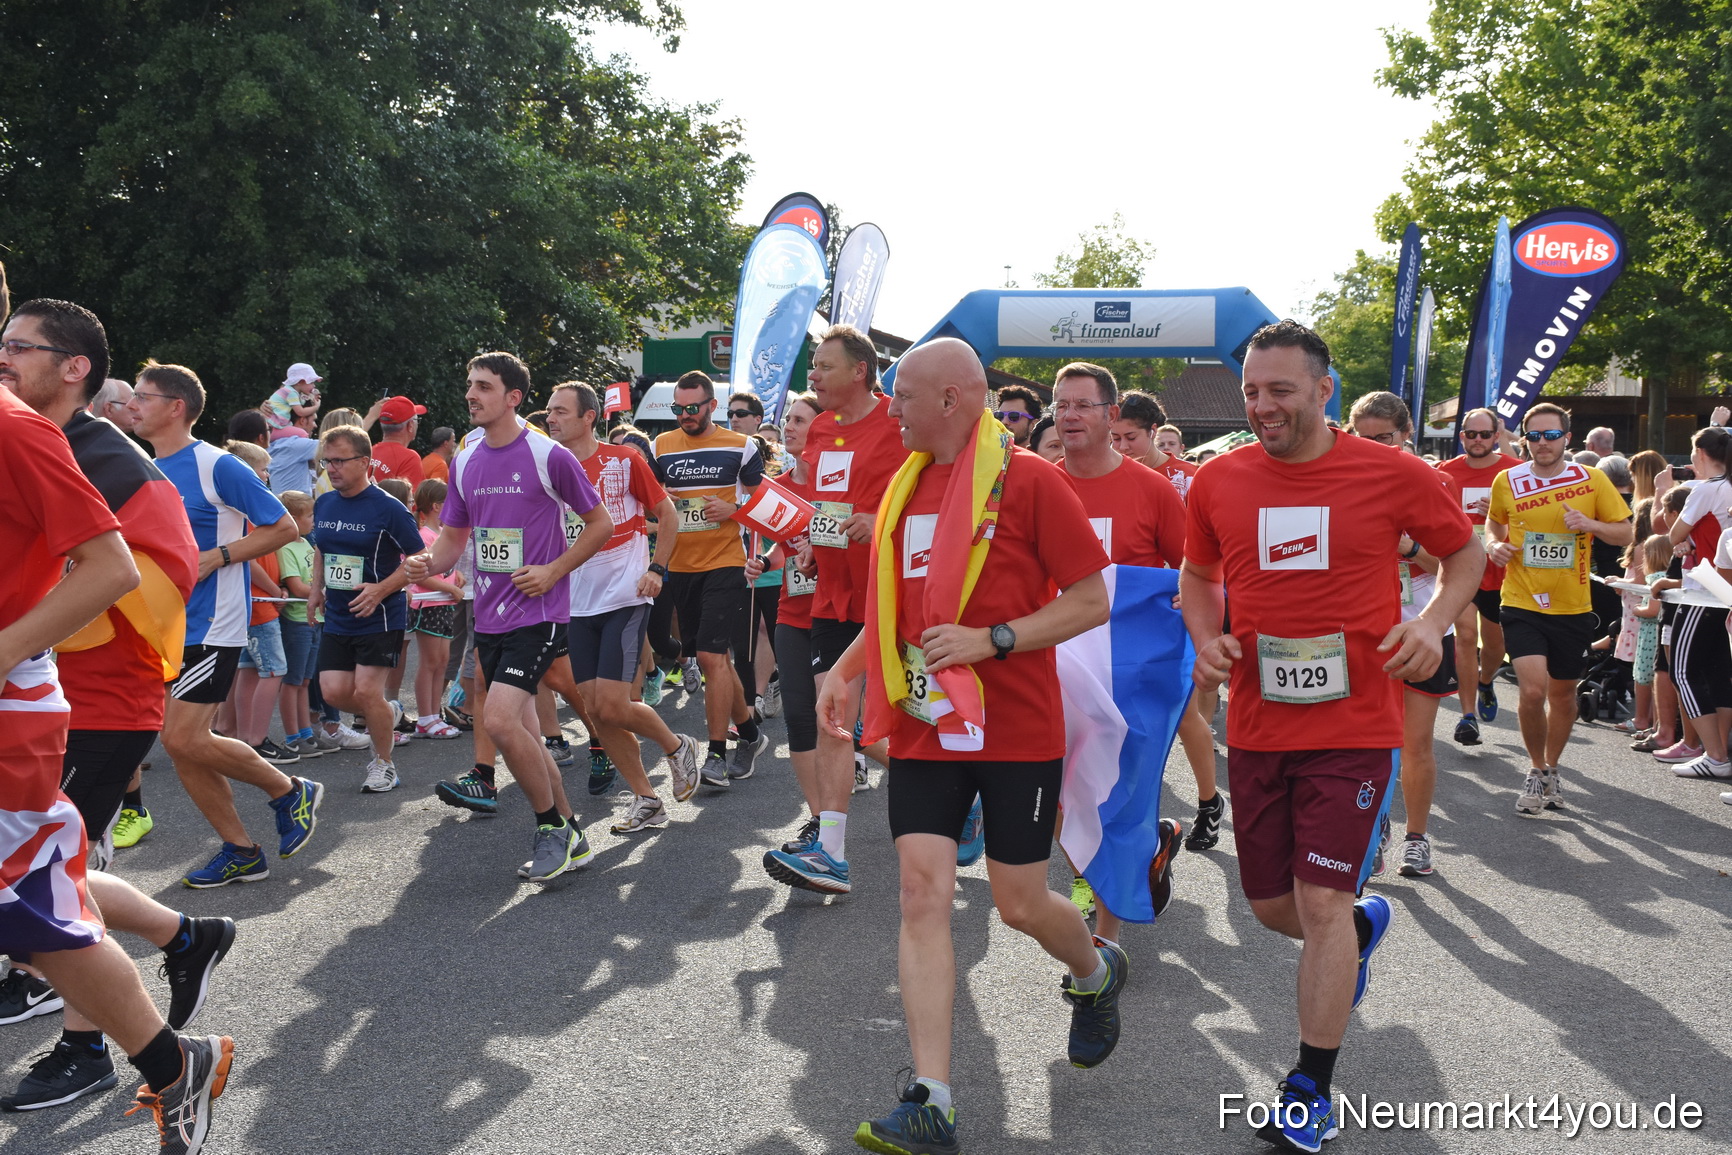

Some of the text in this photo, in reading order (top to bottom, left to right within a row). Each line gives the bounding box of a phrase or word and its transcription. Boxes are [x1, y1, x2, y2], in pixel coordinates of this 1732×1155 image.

[1525, 234, 1609, 265] Hervis
[1081, 323, 1162, 339] firmenlauf
[381, 465, 391, 474] SV
[675, 464, 723, 477] Fischer
[473, 486, 524, 497] WIR SIND LILA.
[1515, 485, 1594, 513] MAX BÖGL
[318, 521, 366, 532] EURO POLES
[811, 517, 837, 534] 552
[481, 544, 509, 560] 905
[1282, 542, 1304, 556] DEHN
[1530, 545, 1569, 559] 1650
[330, 566, 352, 580] 705
[1324, 650, 1341, 659] 2019
[505, 667, 524, 677] JAKO
[1275, 666, 1328, 689] 9129
[1307, 852, 1353, 873] macron
